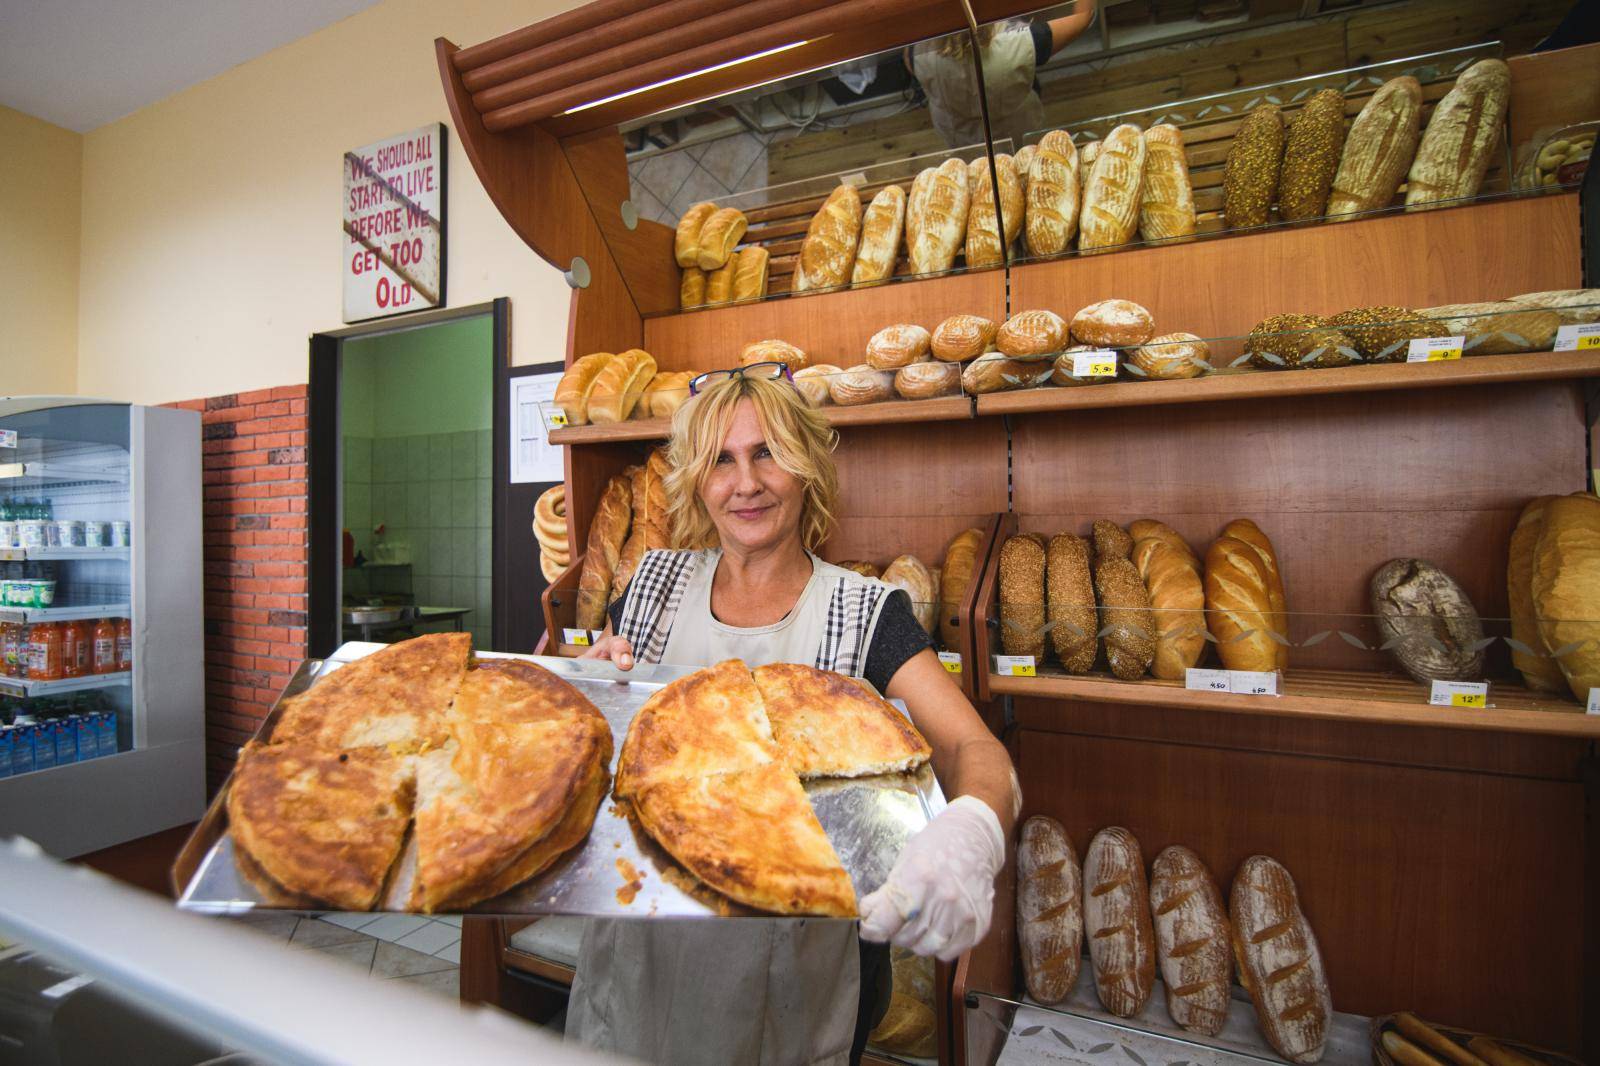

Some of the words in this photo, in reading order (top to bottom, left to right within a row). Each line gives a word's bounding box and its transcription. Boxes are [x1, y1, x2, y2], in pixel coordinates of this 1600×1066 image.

[351, 155, 374, 181] WE
[377, 140, 414, 173] SHOULD
[415, 134, 432, 163] ALL
[350, 179, 385, 212] START
[387, 174, 403, 201] TO
[351, 208, 402, 243] BEFORE
[406, 201, 431, 230] WE
[352, 246, 382, 276] GET
[390, 237, 423, 267] TOO
